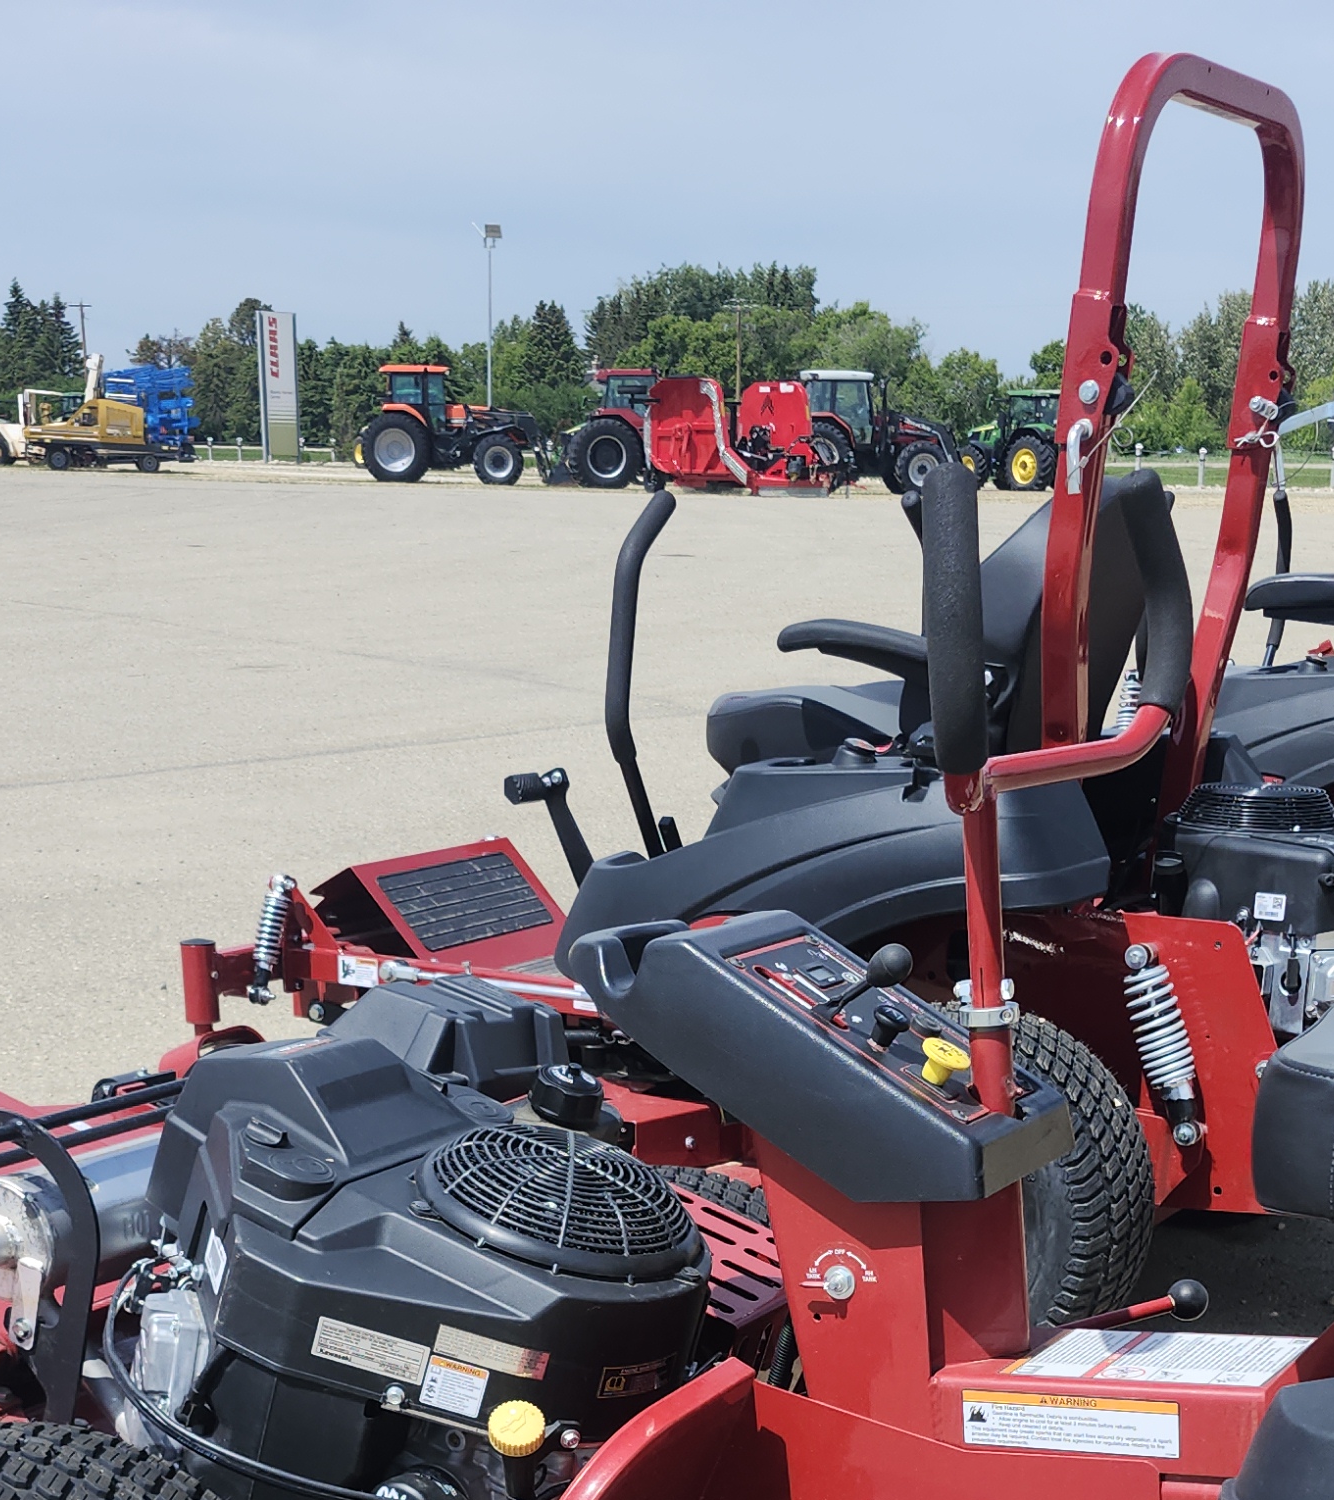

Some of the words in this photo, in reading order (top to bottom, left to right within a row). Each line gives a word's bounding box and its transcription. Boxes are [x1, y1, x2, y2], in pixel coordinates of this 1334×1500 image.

[268, 316, 280, 378] CLAAS
[446, 1362, 481, 1377] WARNING
[1049, 1397, 1097, 1407] WARNING
